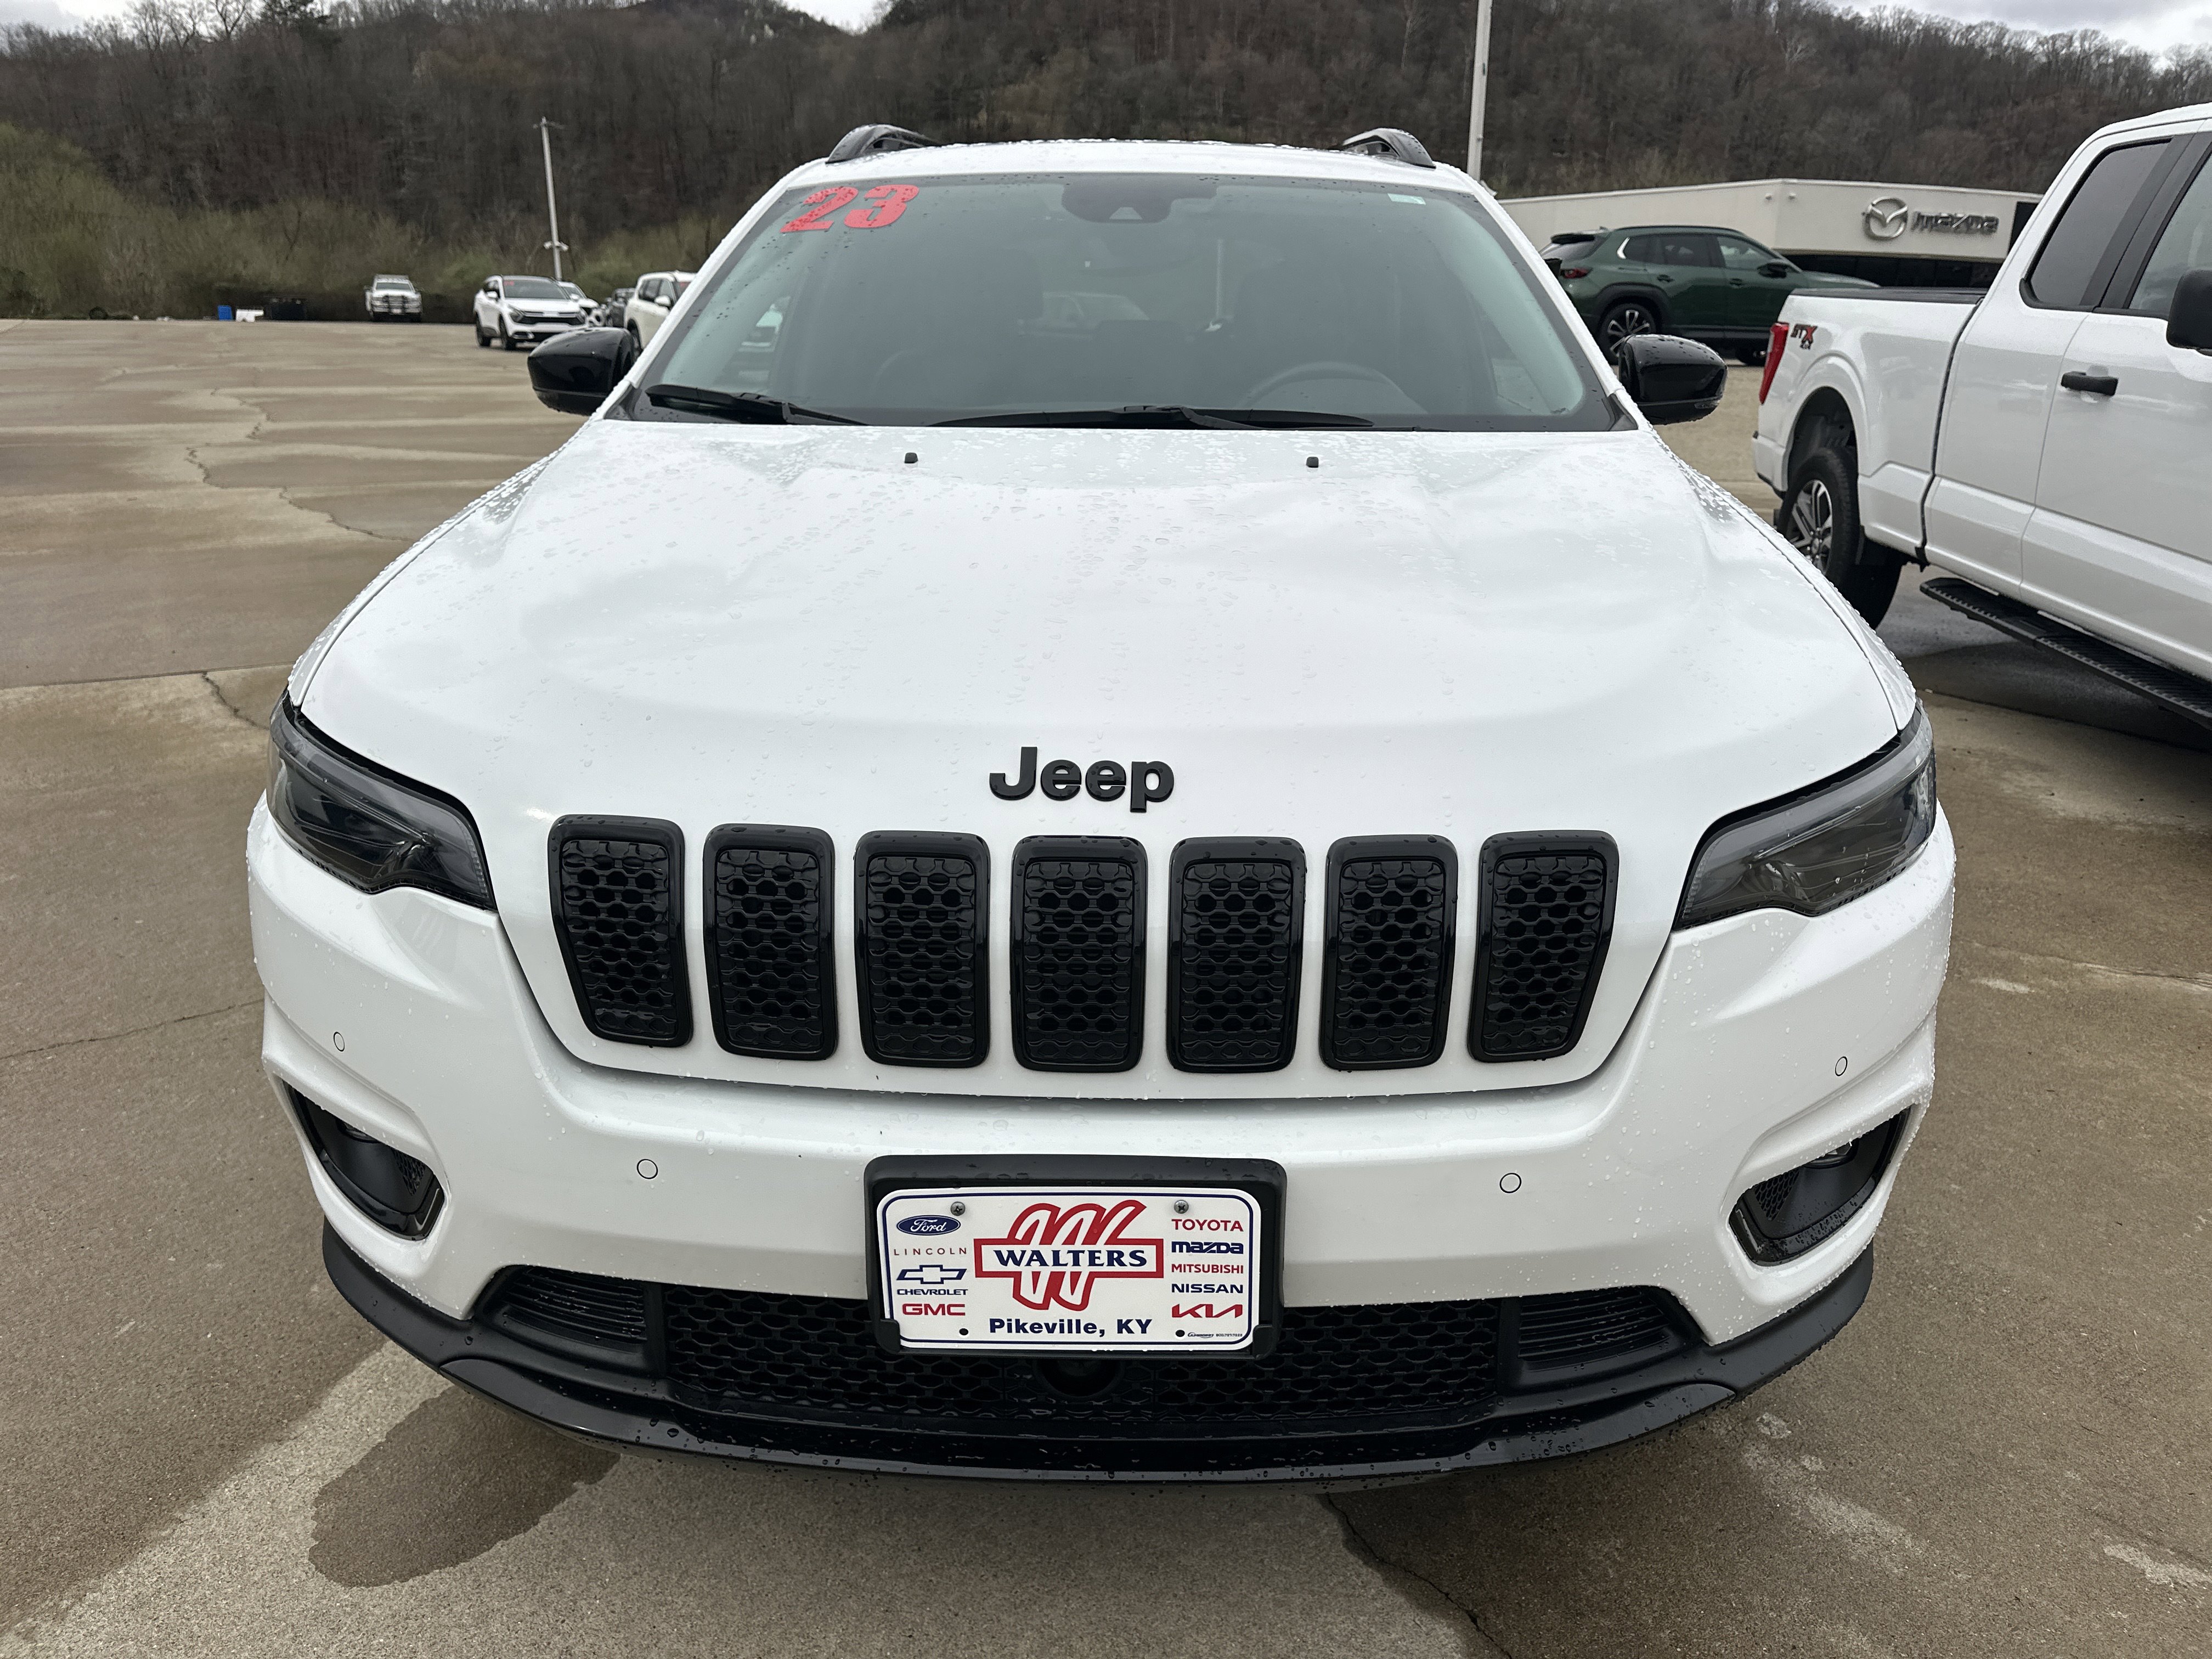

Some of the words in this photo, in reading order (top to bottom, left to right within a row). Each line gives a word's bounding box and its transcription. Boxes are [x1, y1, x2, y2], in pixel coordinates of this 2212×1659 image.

[779, 184, 919, 233] 23
[989, 746, 1175, 812] Jeep
[910, 1219, 947, 1232] Ford
[1171, 1218, 1244, 1232] TOYOTA
[894, 1247, 967, 1256] LINCOLN
[993, 1250, 1147, 1267] WALTERS
[1171, 1263, 1244, 1274] MITSUBISHI
[1171, 1283, 1244, 1294] NISSAN
[902, 1304, 966, 1316] GMC
[1171, 1304, 1243, 1318] KIA
[990, 1318, 1105, 1337] Pikeville,
[1117, 1319, 1152, 1334] KY
